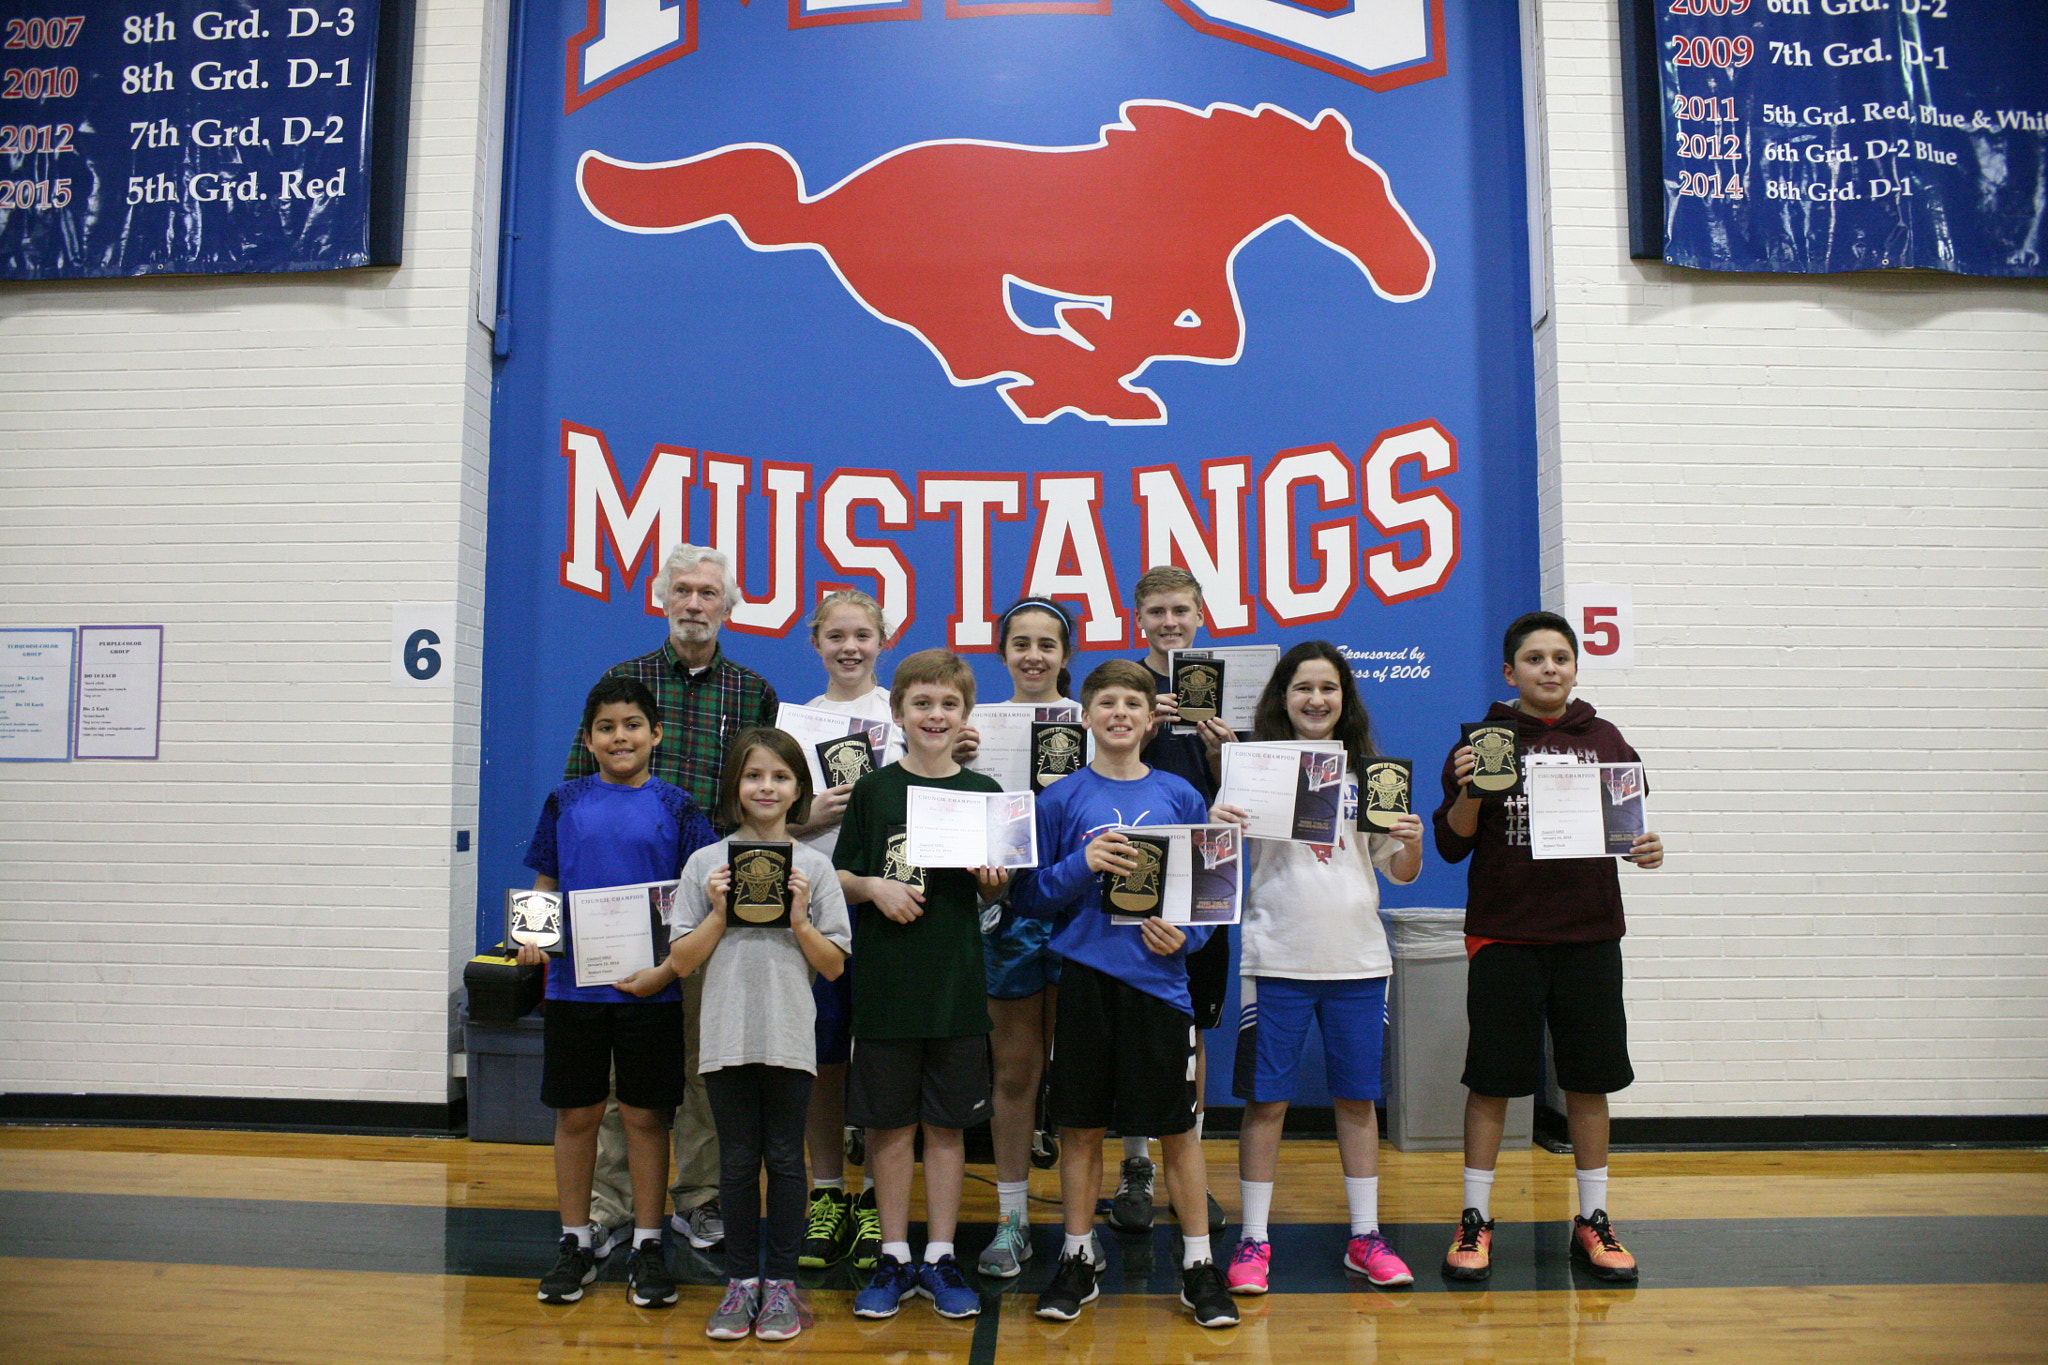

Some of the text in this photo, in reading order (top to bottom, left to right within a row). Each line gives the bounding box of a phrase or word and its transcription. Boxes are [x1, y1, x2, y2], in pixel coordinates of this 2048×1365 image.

[5, 7, 355, 49] 2007 8th Grd. D-3
[1671, 35, 1949, 70] 2009 7th Grd. D-1
[3, 58, 352, 99] 2010 8th Grd. D-1
[1674, 95, 1739, 122] 2011
[1763, 104, 1797, 125] 5th
[1803, 106, 1856, 126] Grd.
[1863, 101, 1916, 124] Red,
[1919, 105, 1966, 129] Blue
[1972, 110, 1991, 129] &
[0, 115, 344, 154] 2012 7th Grd. D-2
[1676, 133, 1958, 166] 2012 6th Grd. D-2 Blue
[0, 167, 347, 209] 2015 5th Grd. Red
[1678, 171, 1913, 202] 2014 8th Grd. D-1
[559, 418, 1460, 654] MUSTANGS
[1583, 606, 1620, 656] 5
[403, 629, 442, 680] 6
[1336, 645, 1426, 664] Sponsored by
[1372, 666, 1389, 683] of
[1390, 665, 1431, 679] 2006
